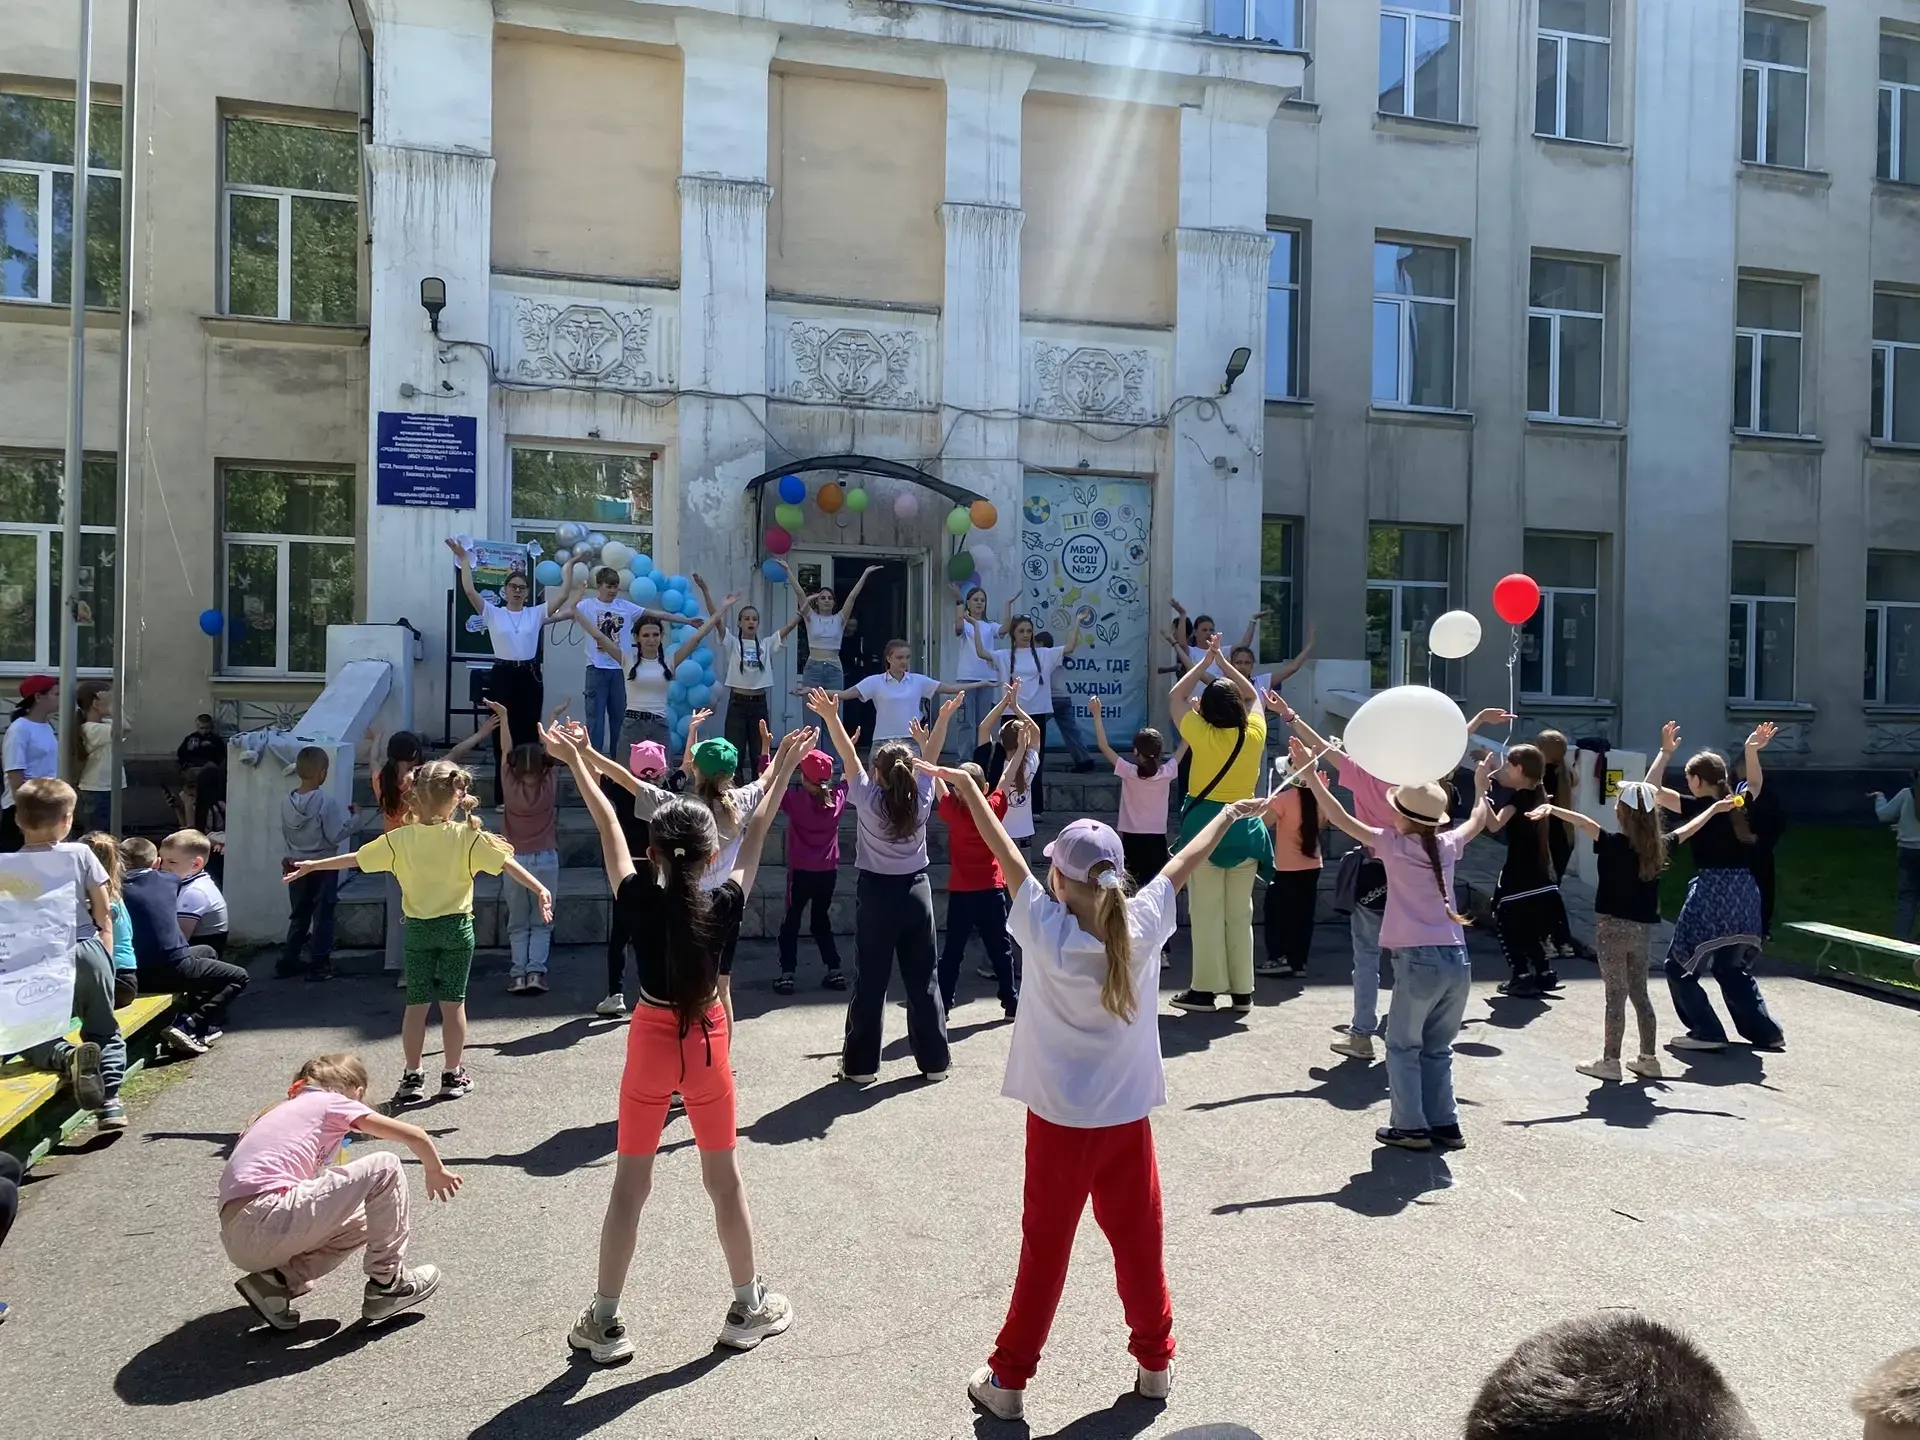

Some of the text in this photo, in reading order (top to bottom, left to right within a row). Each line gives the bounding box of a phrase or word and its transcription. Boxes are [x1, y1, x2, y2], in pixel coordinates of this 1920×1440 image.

[1070, 545, 1100, 554] МБОУ
[1072, 555, 1097, 564] СОШ
[1072, 565, 1098, 574] №27
[1063, 657, 1131, 674] ОЛА, ГДЕ
[1360, 885, 1388, 905] adida
